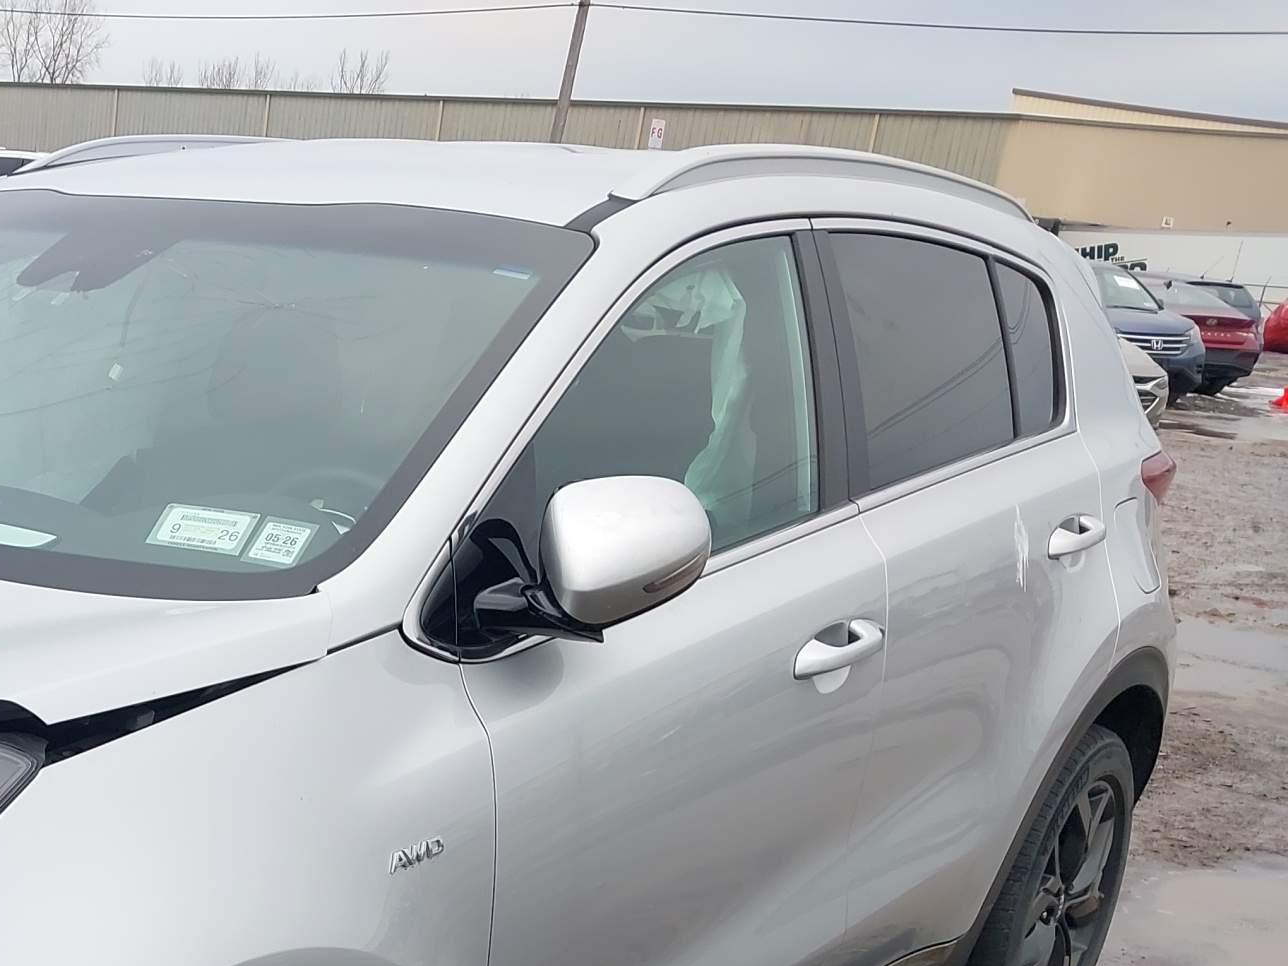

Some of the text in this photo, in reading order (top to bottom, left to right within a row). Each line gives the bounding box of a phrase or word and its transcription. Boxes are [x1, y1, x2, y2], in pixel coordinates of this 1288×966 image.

[169, 523, 182, 534] 9
[217, 529, 241, 543] 26
[389, 837, 444, 874] AWD
